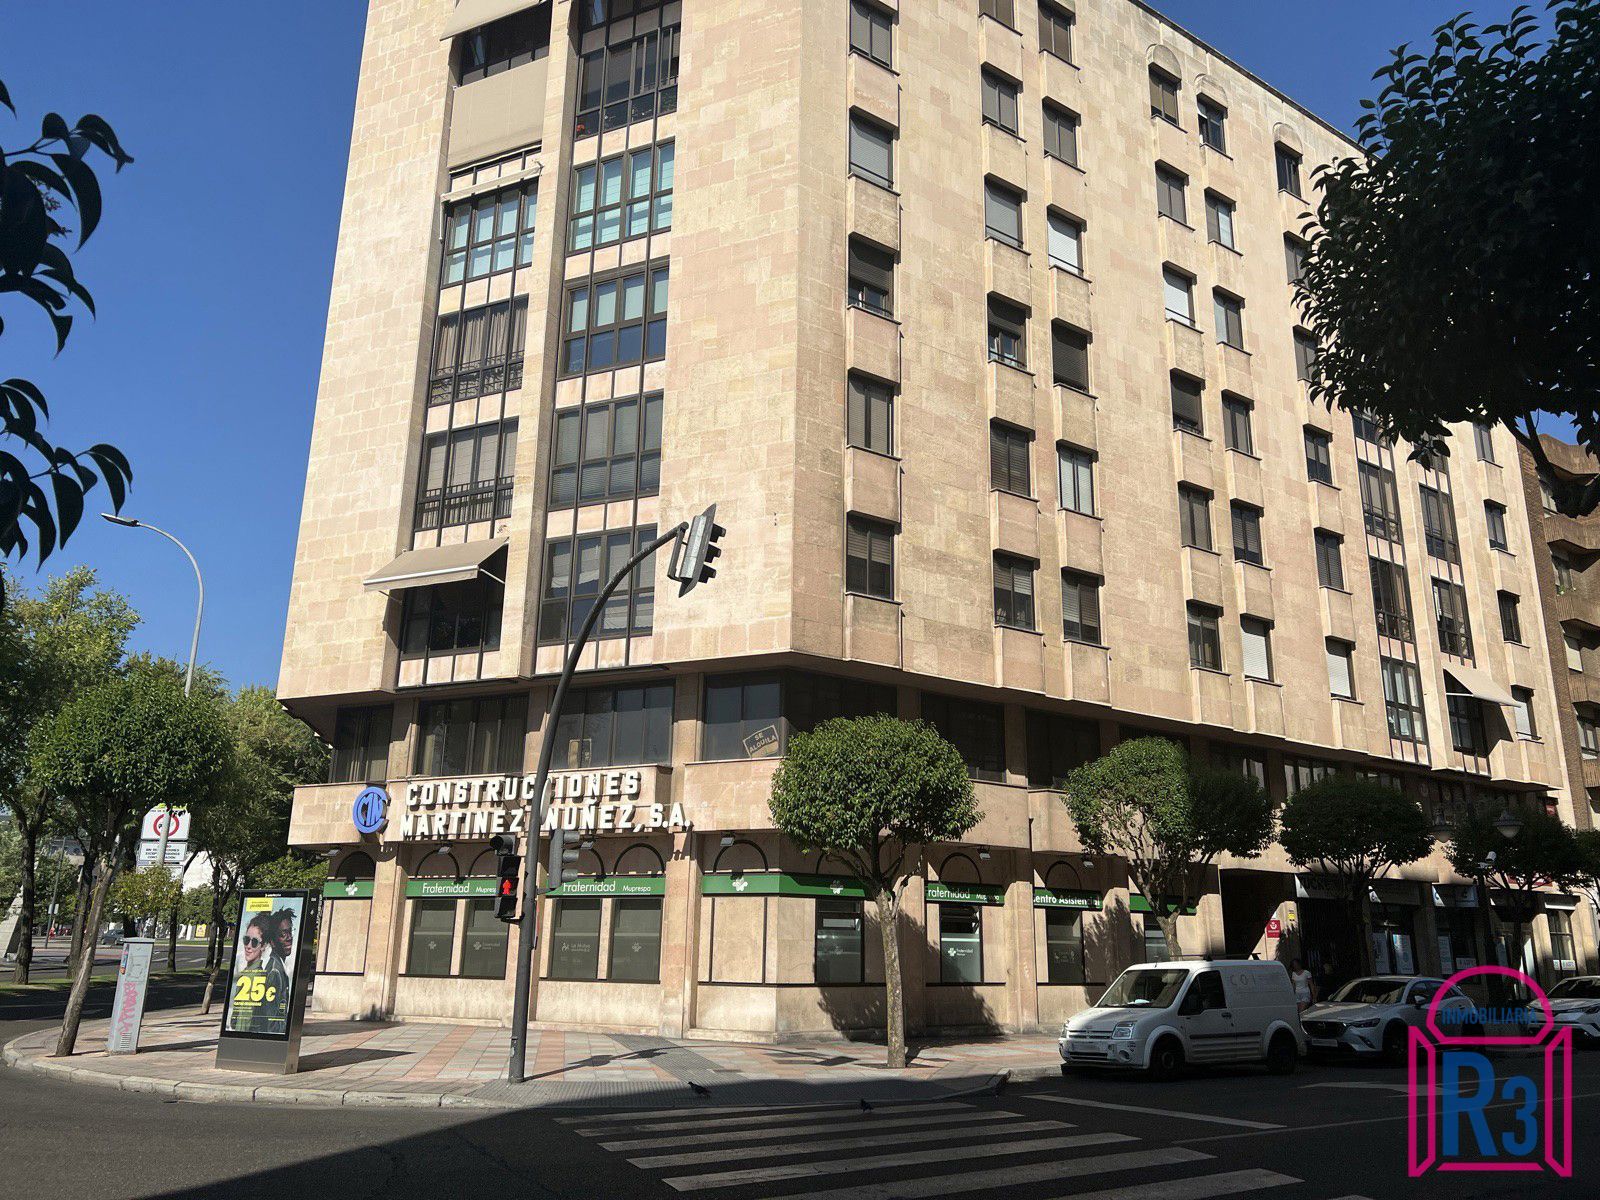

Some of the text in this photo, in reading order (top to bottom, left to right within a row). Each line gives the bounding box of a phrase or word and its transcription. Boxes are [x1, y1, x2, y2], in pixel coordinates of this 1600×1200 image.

[755, 732, 763, 740] SE
[750, 735, 777, 752] ALQUILA
[407, 771, 638, 806] CONSTRUCIONES
[400, 809, 523, 836] MARTINEZ
[649, 802, 691, 829] S.A.
[422, 882, 470, 894] Fraternidad
[562, 881, 651, 893] Fraternidad Muprespa
[928, 886, 971, 899] raternidad
[1034, 894, 1057, 904] entro
